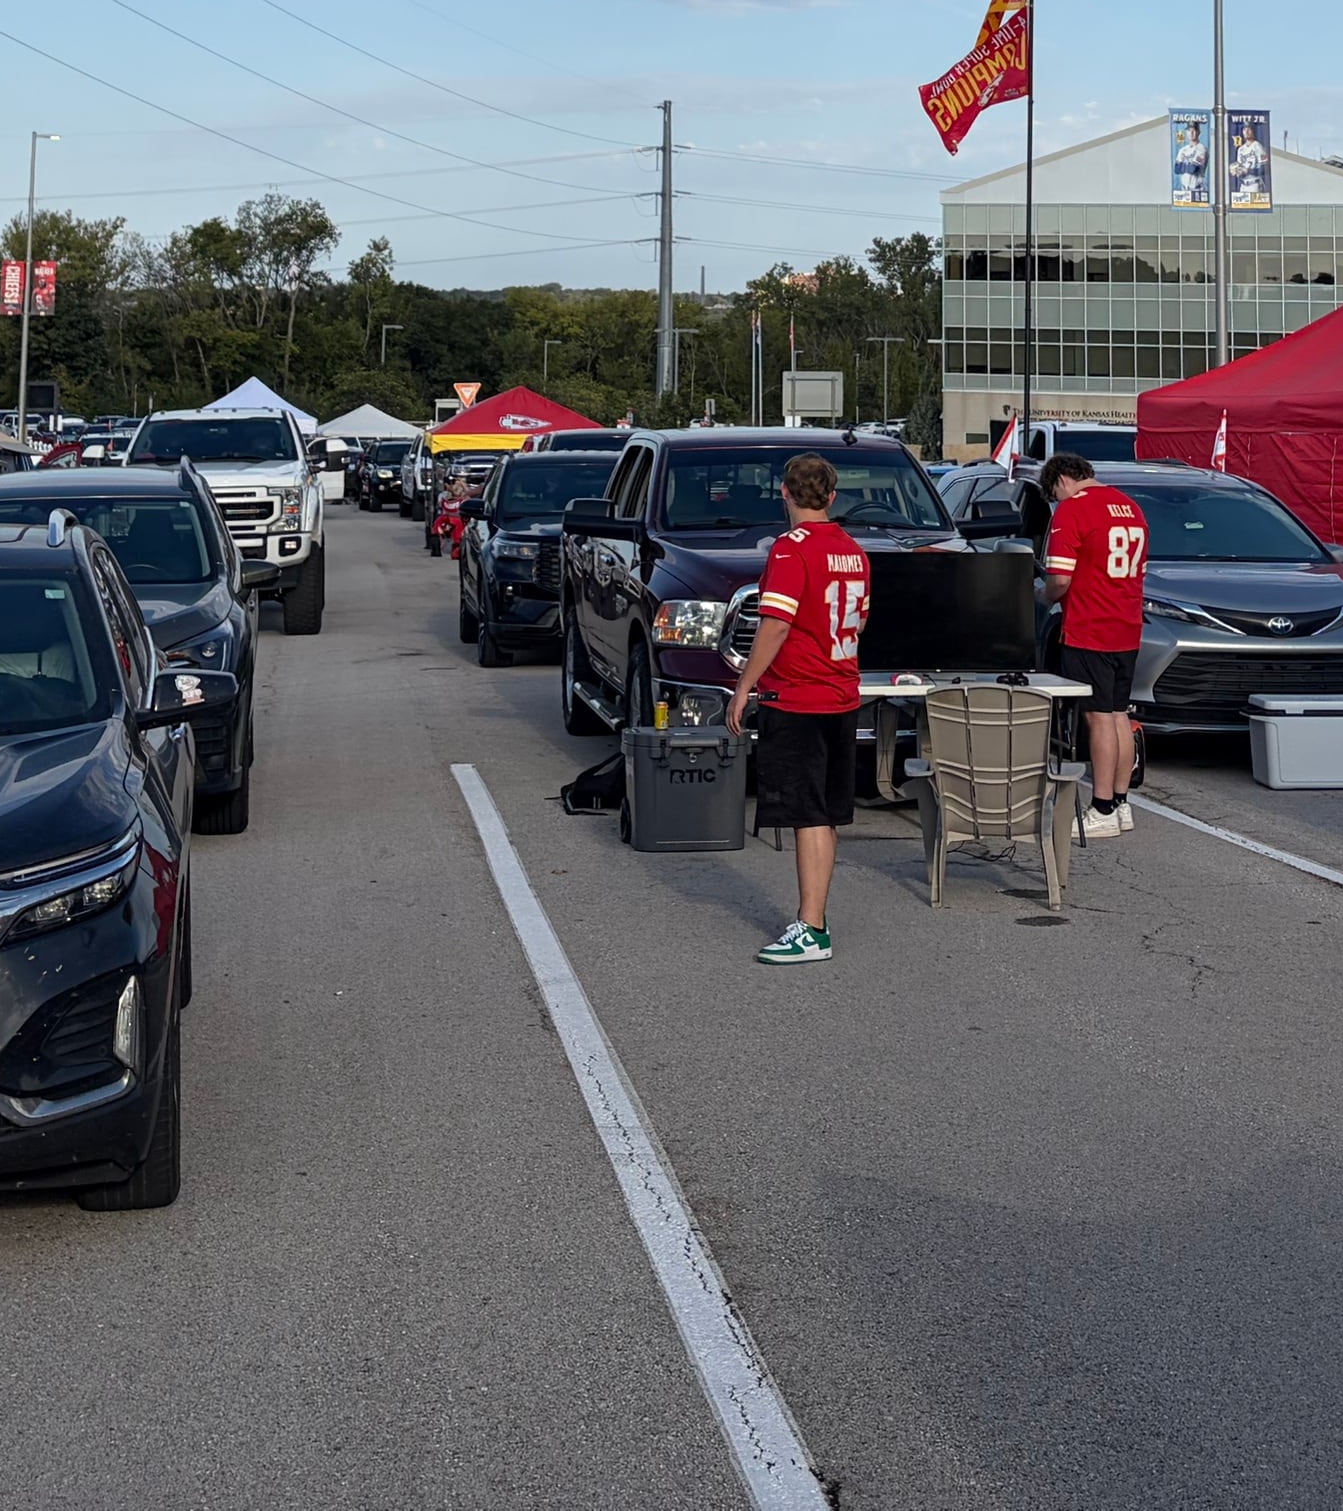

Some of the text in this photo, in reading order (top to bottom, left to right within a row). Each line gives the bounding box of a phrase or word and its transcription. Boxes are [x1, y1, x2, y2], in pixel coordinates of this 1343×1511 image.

[1231, 115, 1252, 123] WITT
[1082, 410, 1111, 418] KANSAS
[1107, 526, 1145, 578] 87
[824, 580, 865, 661] 15
[669, 768, 716, 784] RTIC
